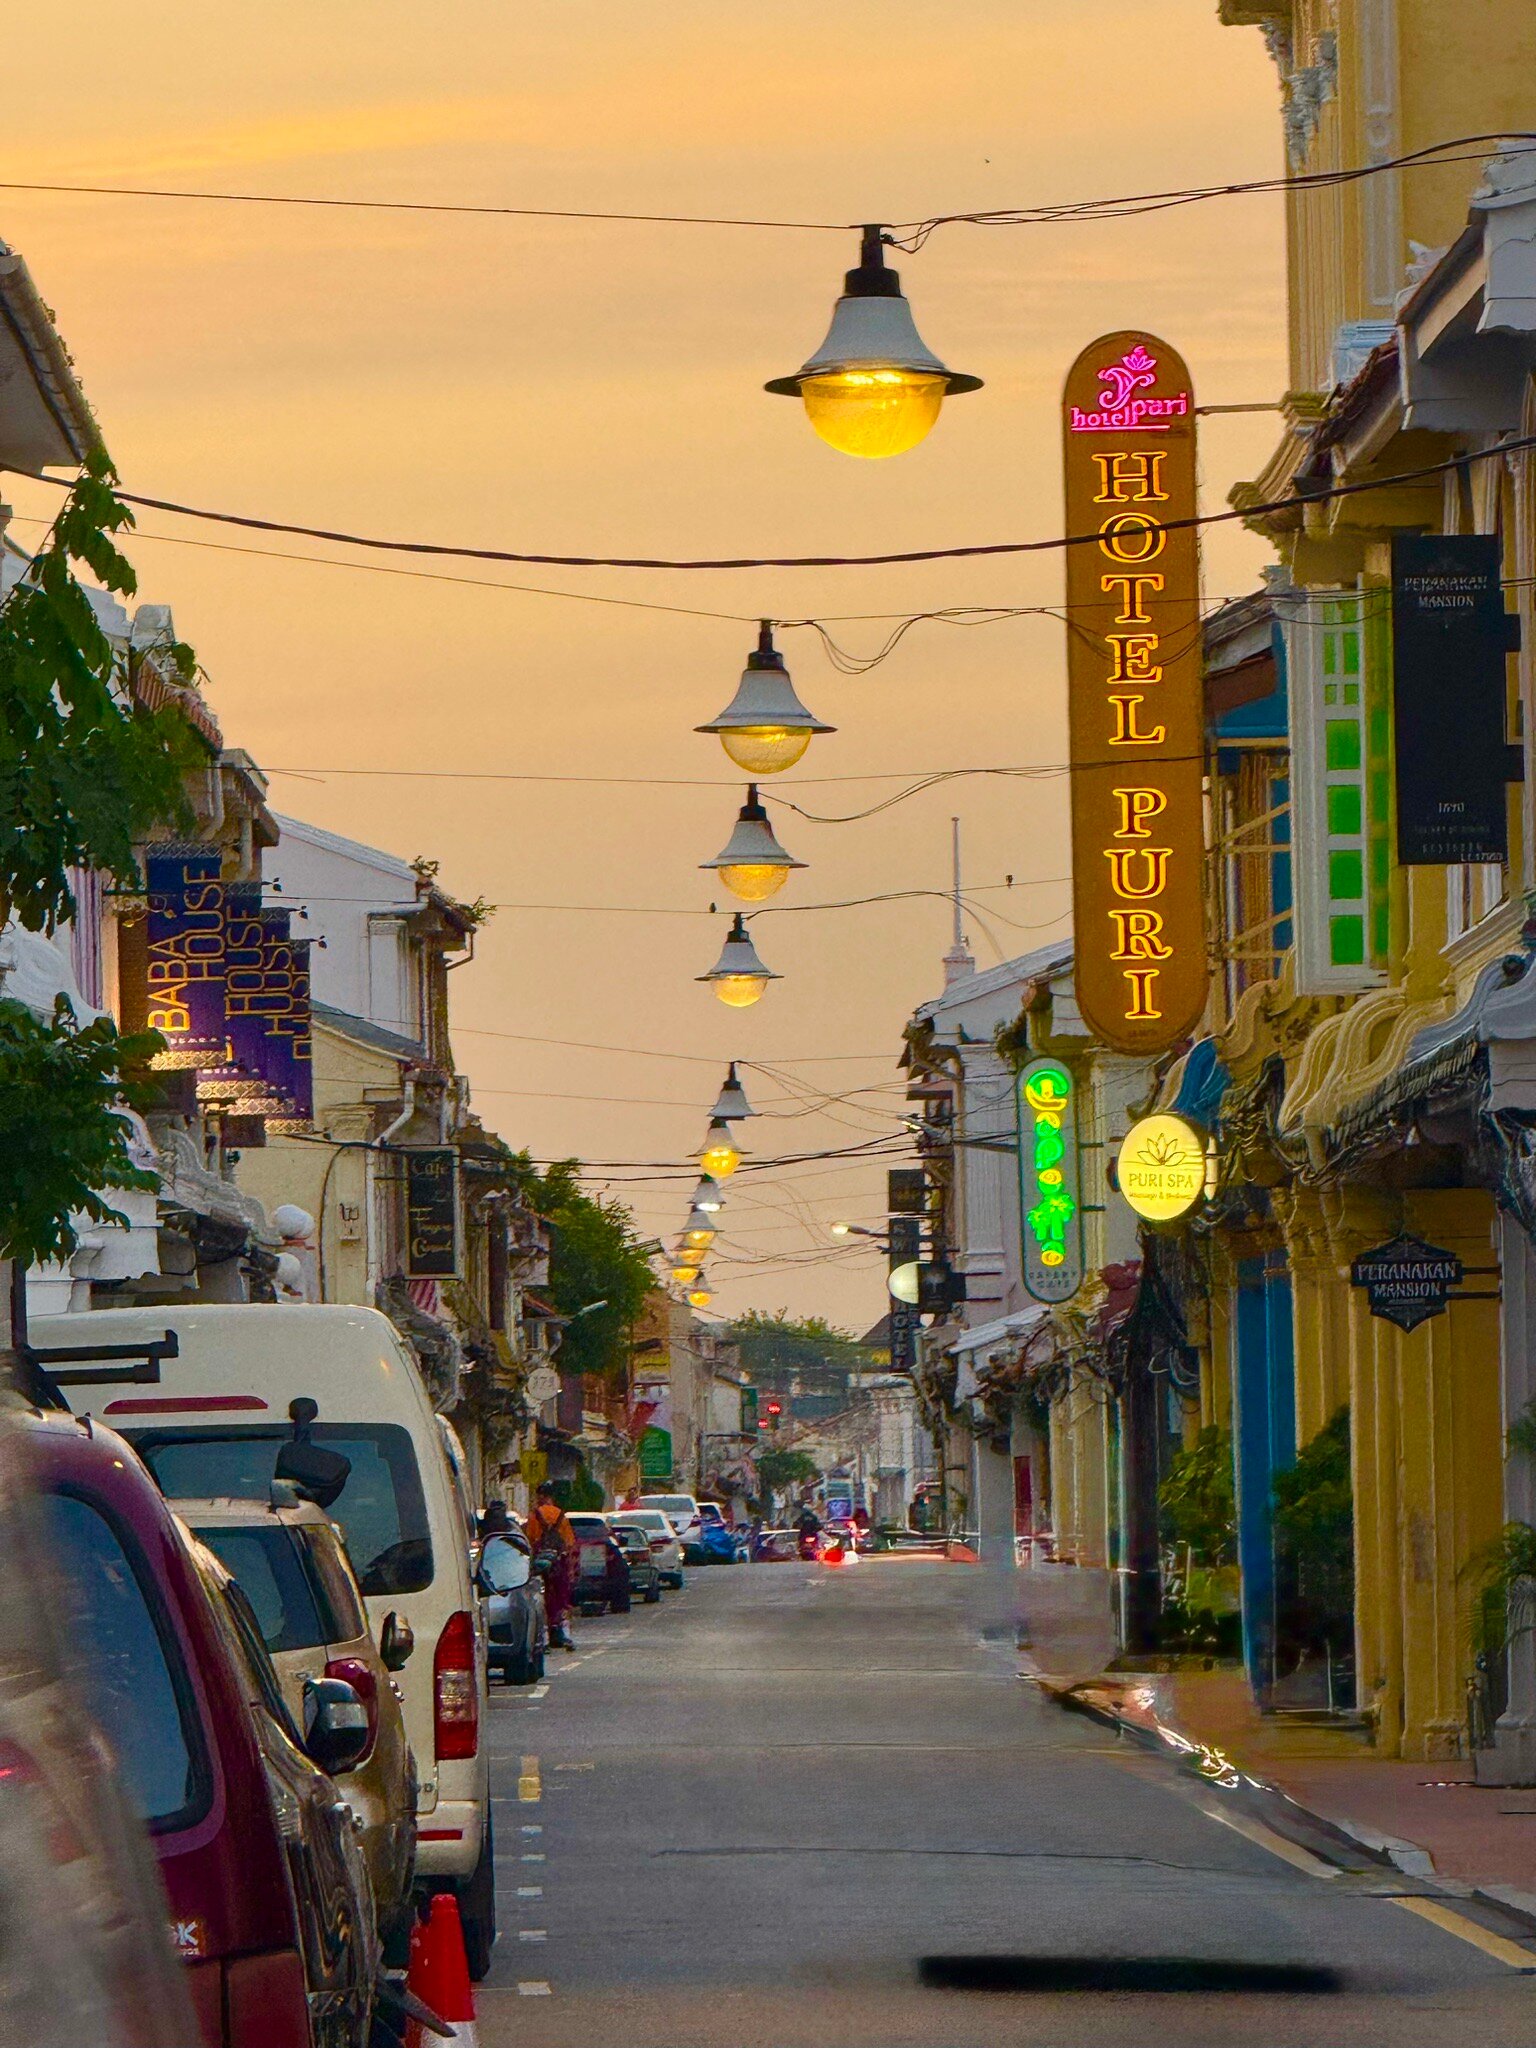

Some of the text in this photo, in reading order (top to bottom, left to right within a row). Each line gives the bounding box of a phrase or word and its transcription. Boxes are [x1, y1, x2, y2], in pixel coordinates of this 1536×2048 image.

[1070, 405, 1129, 427] hotel
[1091, 451, 1170, 746] HOTEL
[1418, 594, 1475, 609] MANSION
[1104, 787, 1173, 1019] PURI
[183, 864, 226, 982] HOUSE
[147, 931, 191, 1032] BABA
[1129, 1172, 1194, 1189] PURI SPA
[1357, 1261, 1457, 1281] PERANAKAN
[1374, 1281, 1442, 1298] MANSION
